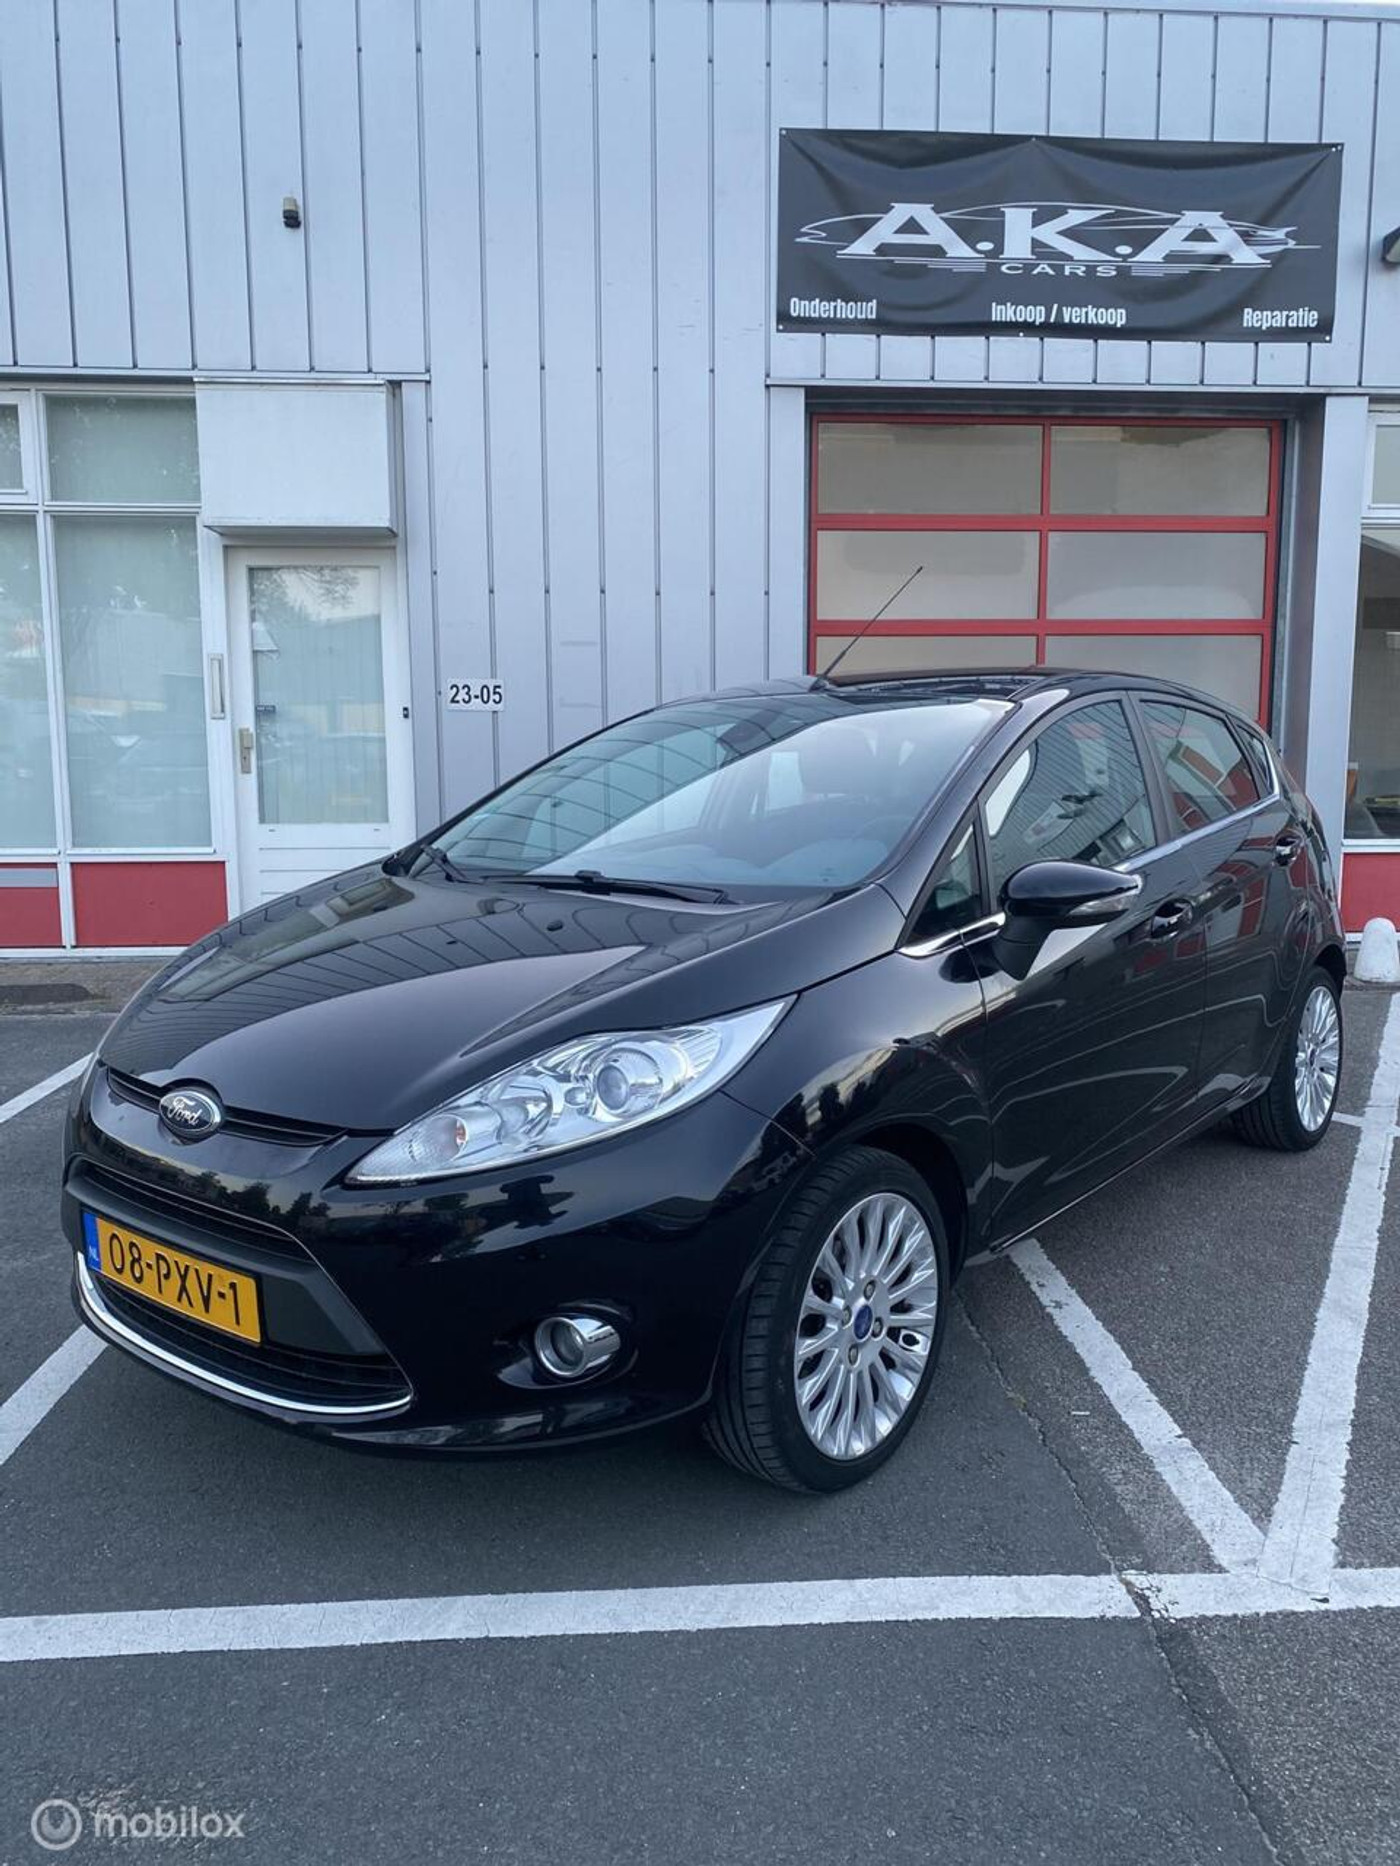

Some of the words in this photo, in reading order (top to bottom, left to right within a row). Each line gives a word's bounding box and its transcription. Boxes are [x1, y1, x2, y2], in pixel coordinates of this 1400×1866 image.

[837, 202, 1271, 264] A.K.A
[1000, 263, 1118, 277] CARS
[790, 297, 877, 319] Onderhoud
[991, 302, 1046, 325] Inkoop
[1050, 303, 1058, 323] /
[1062, 305, 1126, 327] verkoop
[1243, 307, 1319, 330] Reparatie
[449, 684, 503, 704] 23-05
[169, 1096, 203, 1125] Ford
[109, 1232, 240, 1326] 08-PXV-1
